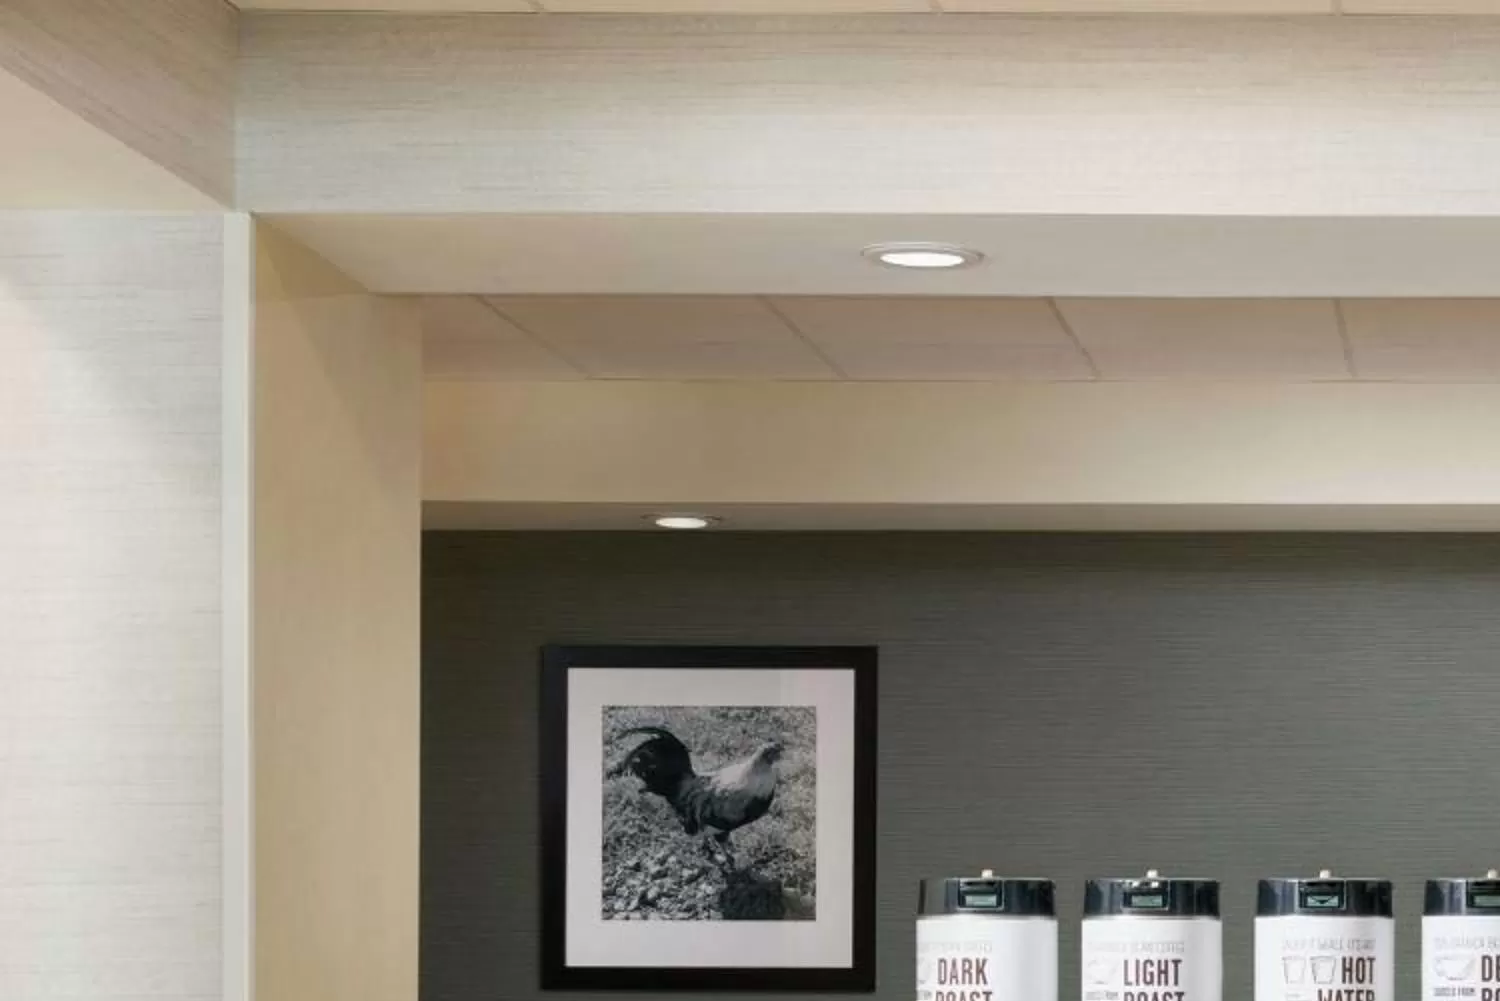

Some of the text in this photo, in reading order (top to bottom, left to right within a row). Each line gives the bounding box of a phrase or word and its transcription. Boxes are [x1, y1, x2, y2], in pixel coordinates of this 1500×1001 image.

[937, 958, 988, 985] DARK
[1123, 959, 1183, 986] LIGHT
[1341, 956, 1376, 985] HOT
